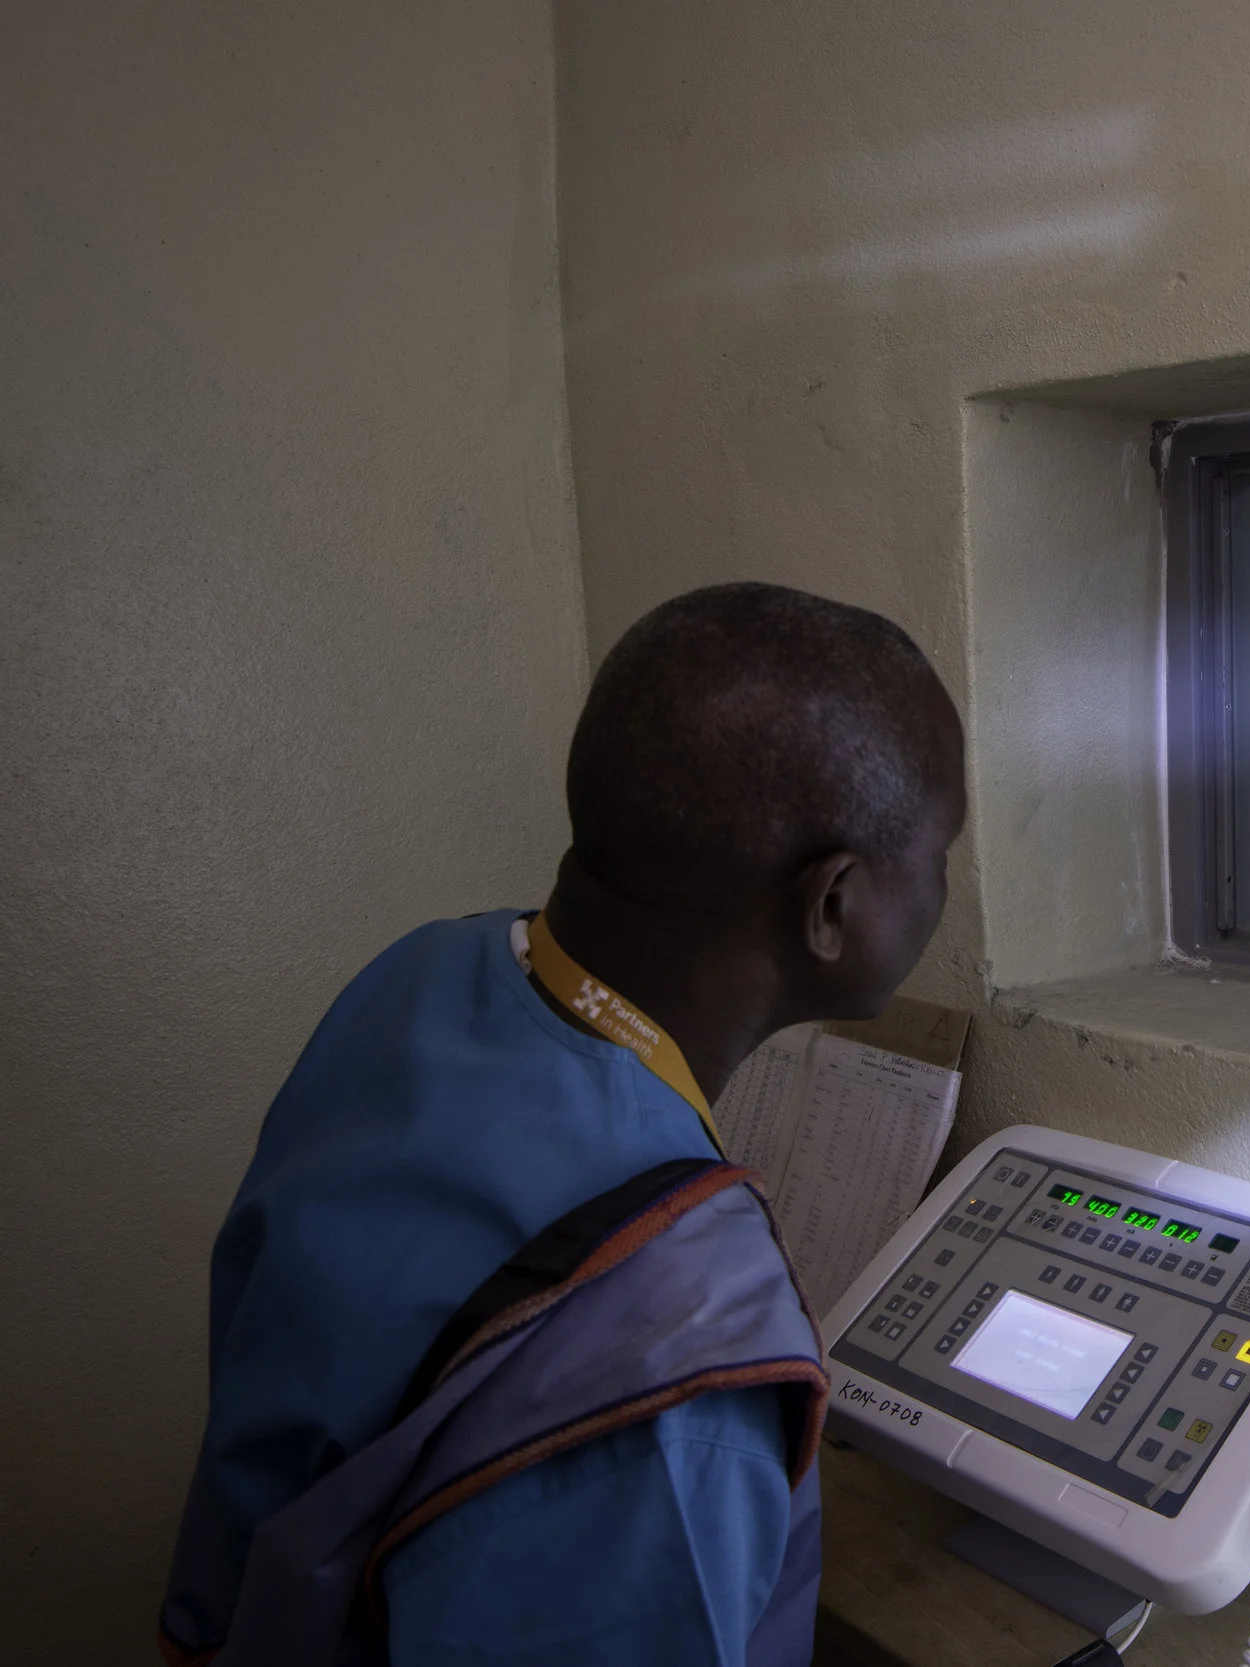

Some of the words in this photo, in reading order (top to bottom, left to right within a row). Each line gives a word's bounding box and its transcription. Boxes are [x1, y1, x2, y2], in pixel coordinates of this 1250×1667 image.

[600, 1014, 613, 1029] in
[614, 1024, 653, 1060] Health
[609, 998, 660, 1045] Partners
[1123, 1212, 1158, 1231] 320
[838, 1379, 923, 1426] KON-0708
